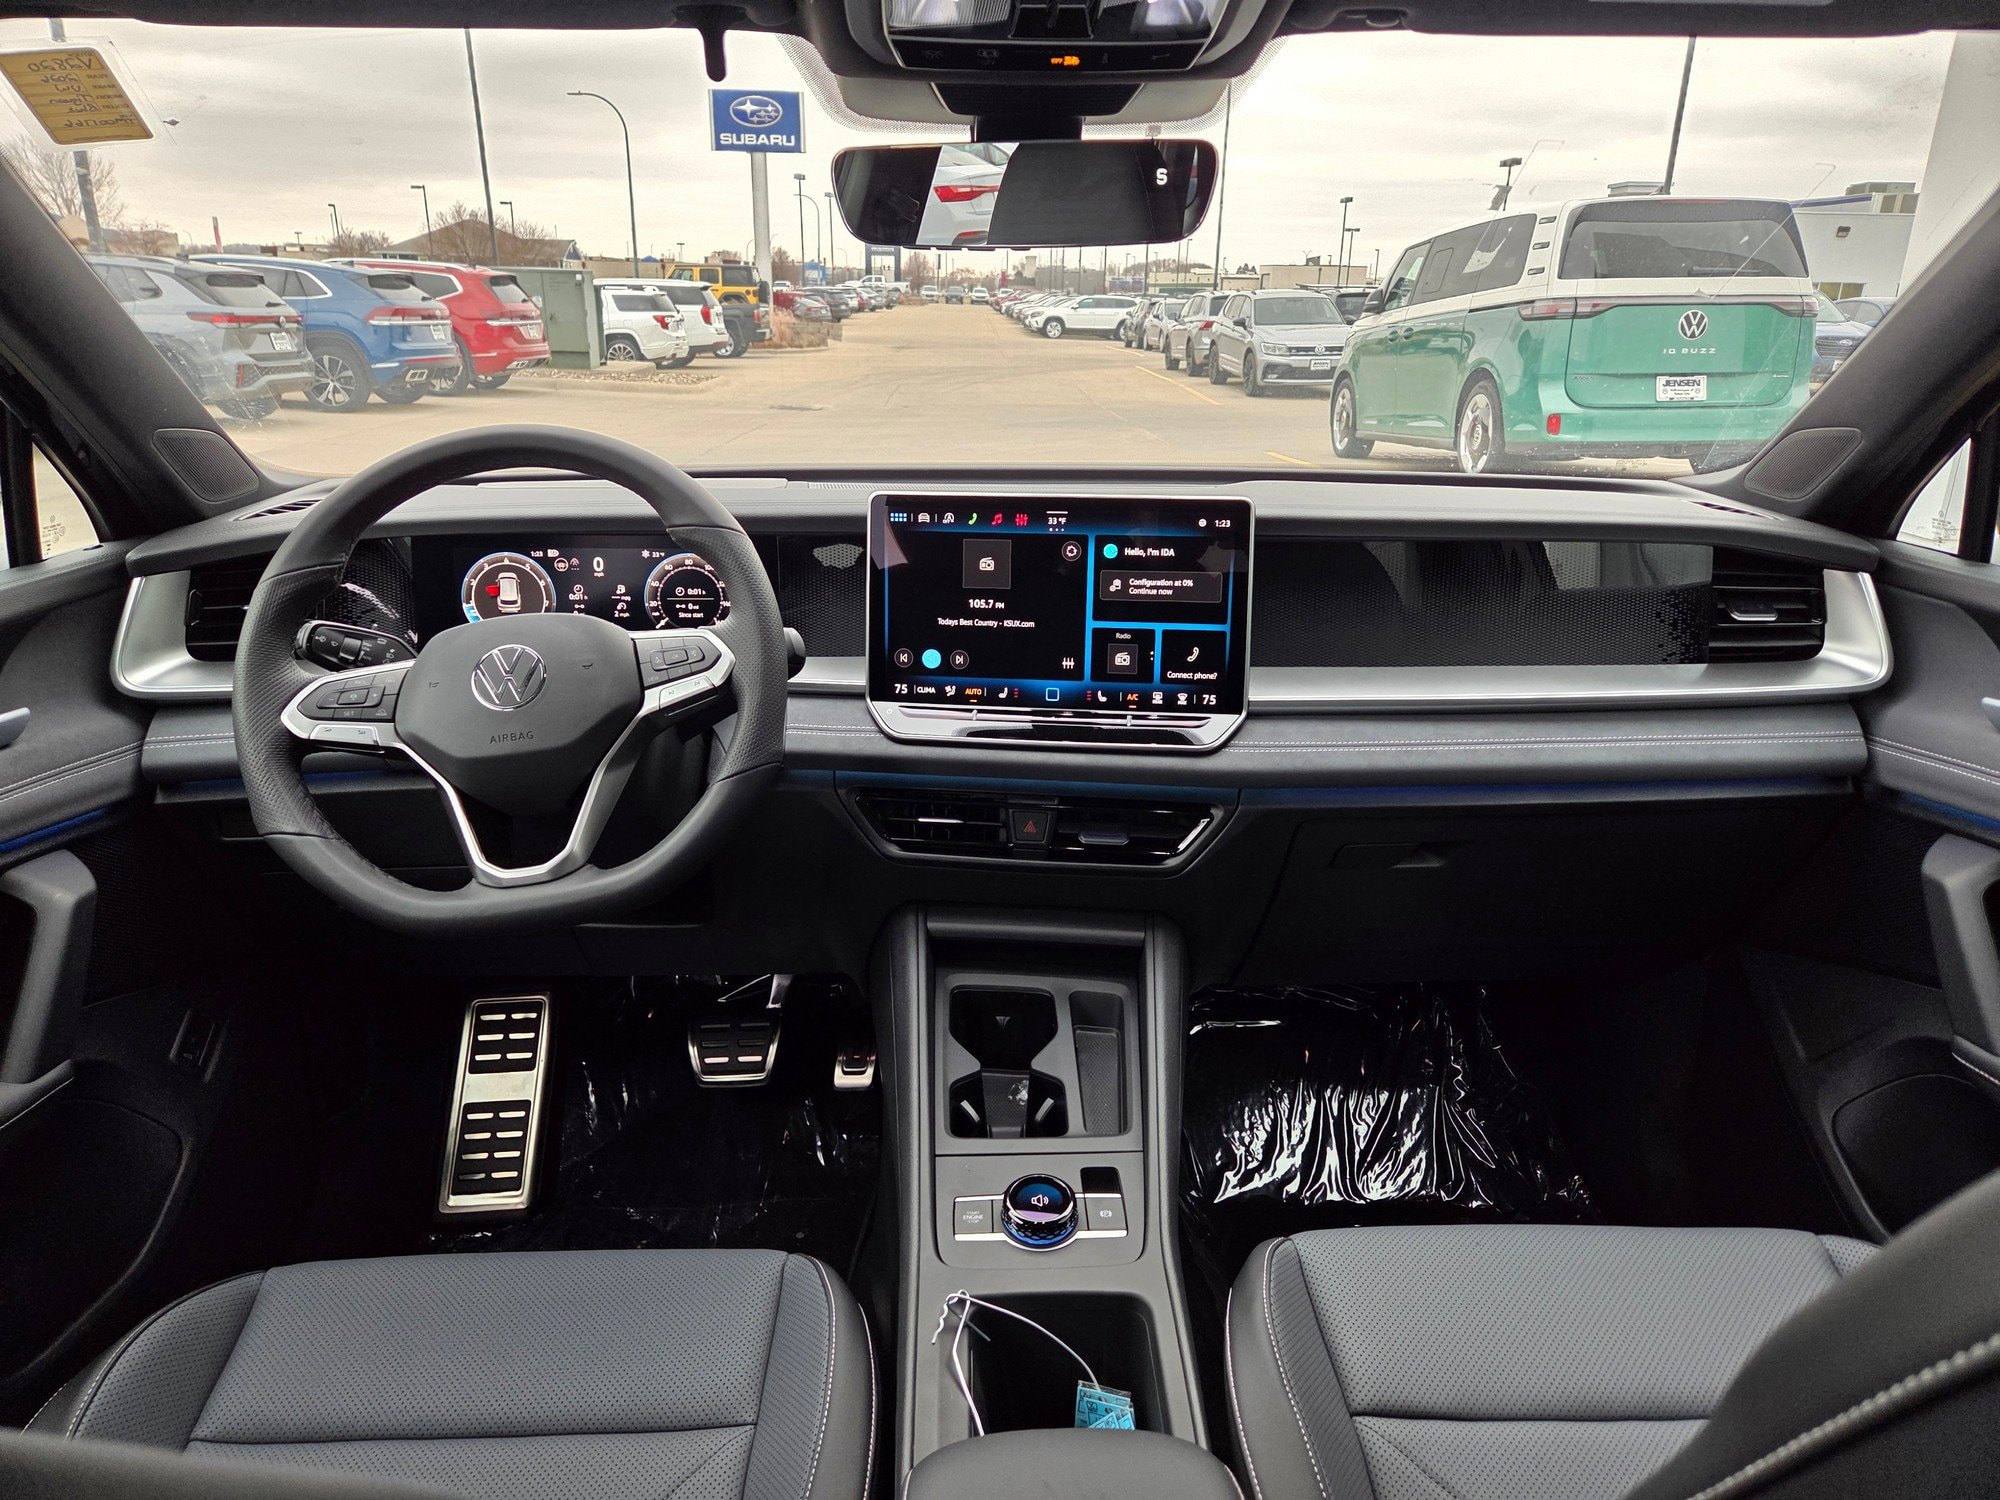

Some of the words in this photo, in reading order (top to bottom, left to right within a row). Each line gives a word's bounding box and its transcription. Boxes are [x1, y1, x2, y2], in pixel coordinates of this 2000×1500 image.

[720, 132, 796, 146] SUBARU
[1156, 168, 1168, 186] S
[1662, 379, 1700, 388] JENSEN
[1048, 517, 1058, 525] 33
[1215, 520, 1230, 528] 1:23
[1124, 548, 1146, 557] Hello,
[1147, 548, 1160, 556] I'm
[1160, 548, 1175, 556] IDA
[592, 556, 604, 572] 0
[1128, 578, 1174, 588] Configuration
[968, 598, 994, 608] 105.7
[937, 618, 958, 627] Todays
[974, 619, 998, 628] Country
[1167, 671, 1193, 679] Connect
[1194, 672, 1218, 680] phone?
[894, 684, 908, 694] 75
[1126, 693, 1138, 701] A/C
[1202, 694, 1216, 705] 75
[490, 730, 534, 744] AIRBAG
